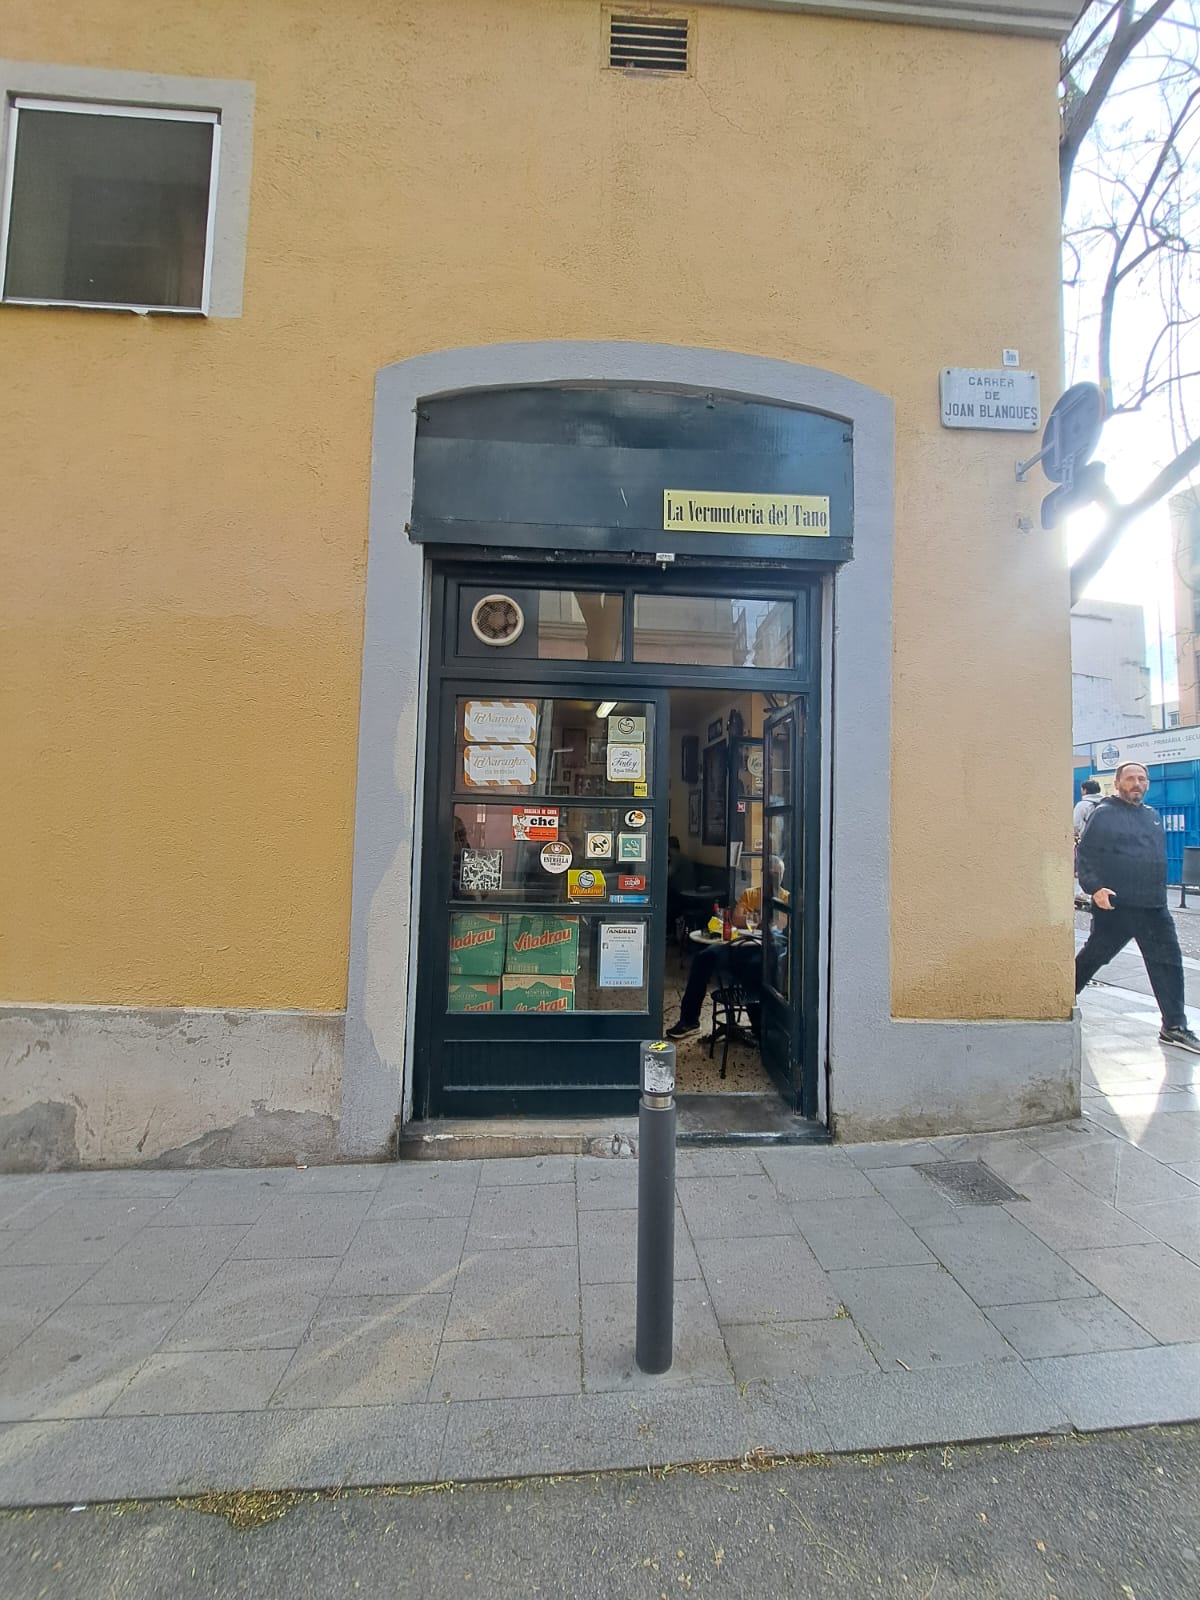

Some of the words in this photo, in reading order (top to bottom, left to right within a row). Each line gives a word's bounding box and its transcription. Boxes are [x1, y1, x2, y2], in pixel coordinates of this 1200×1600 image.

[968, 376, 1015, 388] CARRER
[984, 391, 1000, 401] DE
[945, 402, 974, 417] JOAN
[979, 404, 1038, 420] BLANQUES
[667, 499, 684, 521] La
[688, 500, 764, 525] Vermuteria
[768, 503, 789, 526] del
[792, 504, 827, 527] Tano
[530, 816, 555, 826] che
[543, 856, 569, 864] ESTRELLA
[513, 927, 572, 952] Viladrau
